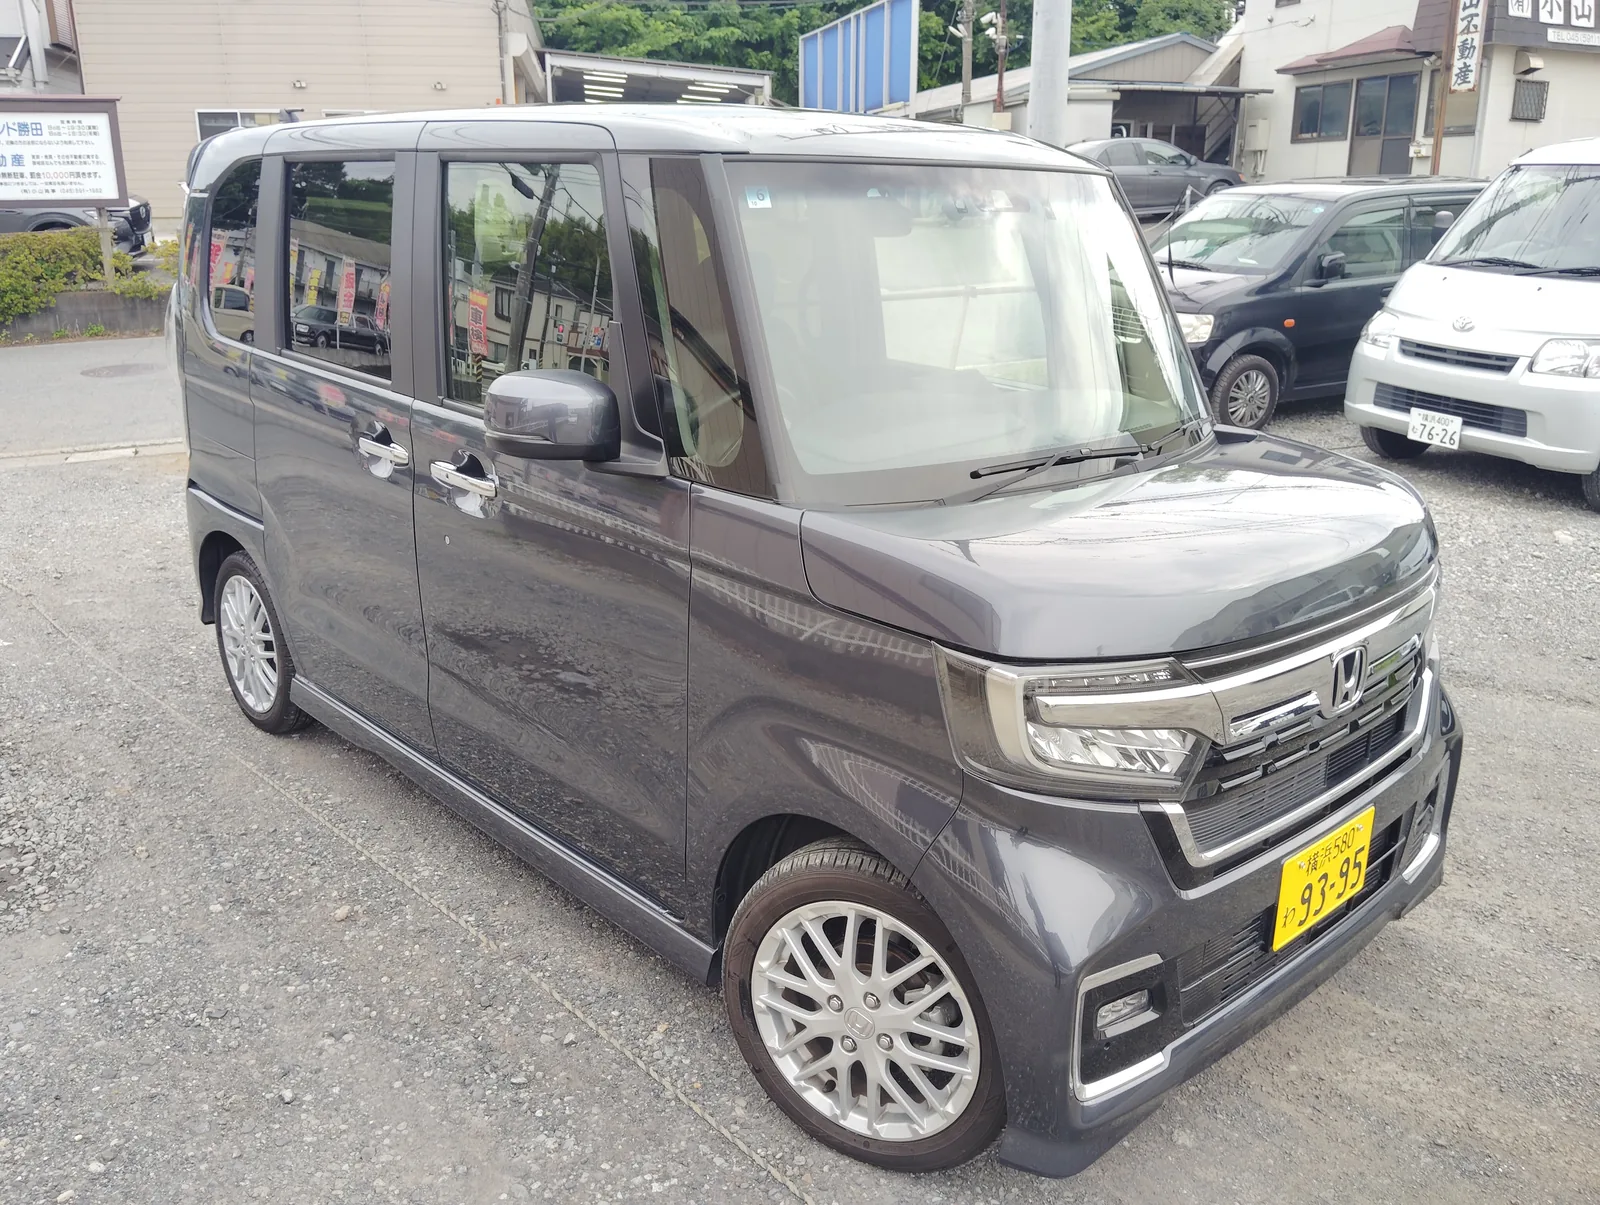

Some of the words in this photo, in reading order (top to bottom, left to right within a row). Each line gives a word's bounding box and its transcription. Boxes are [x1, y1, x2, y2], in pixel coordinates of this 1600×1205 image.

[1419, 423, 1457, 446] 76-26
[1281, 906, 1296, 929] わ
[1298, 845, 1366, 928] 93-95
